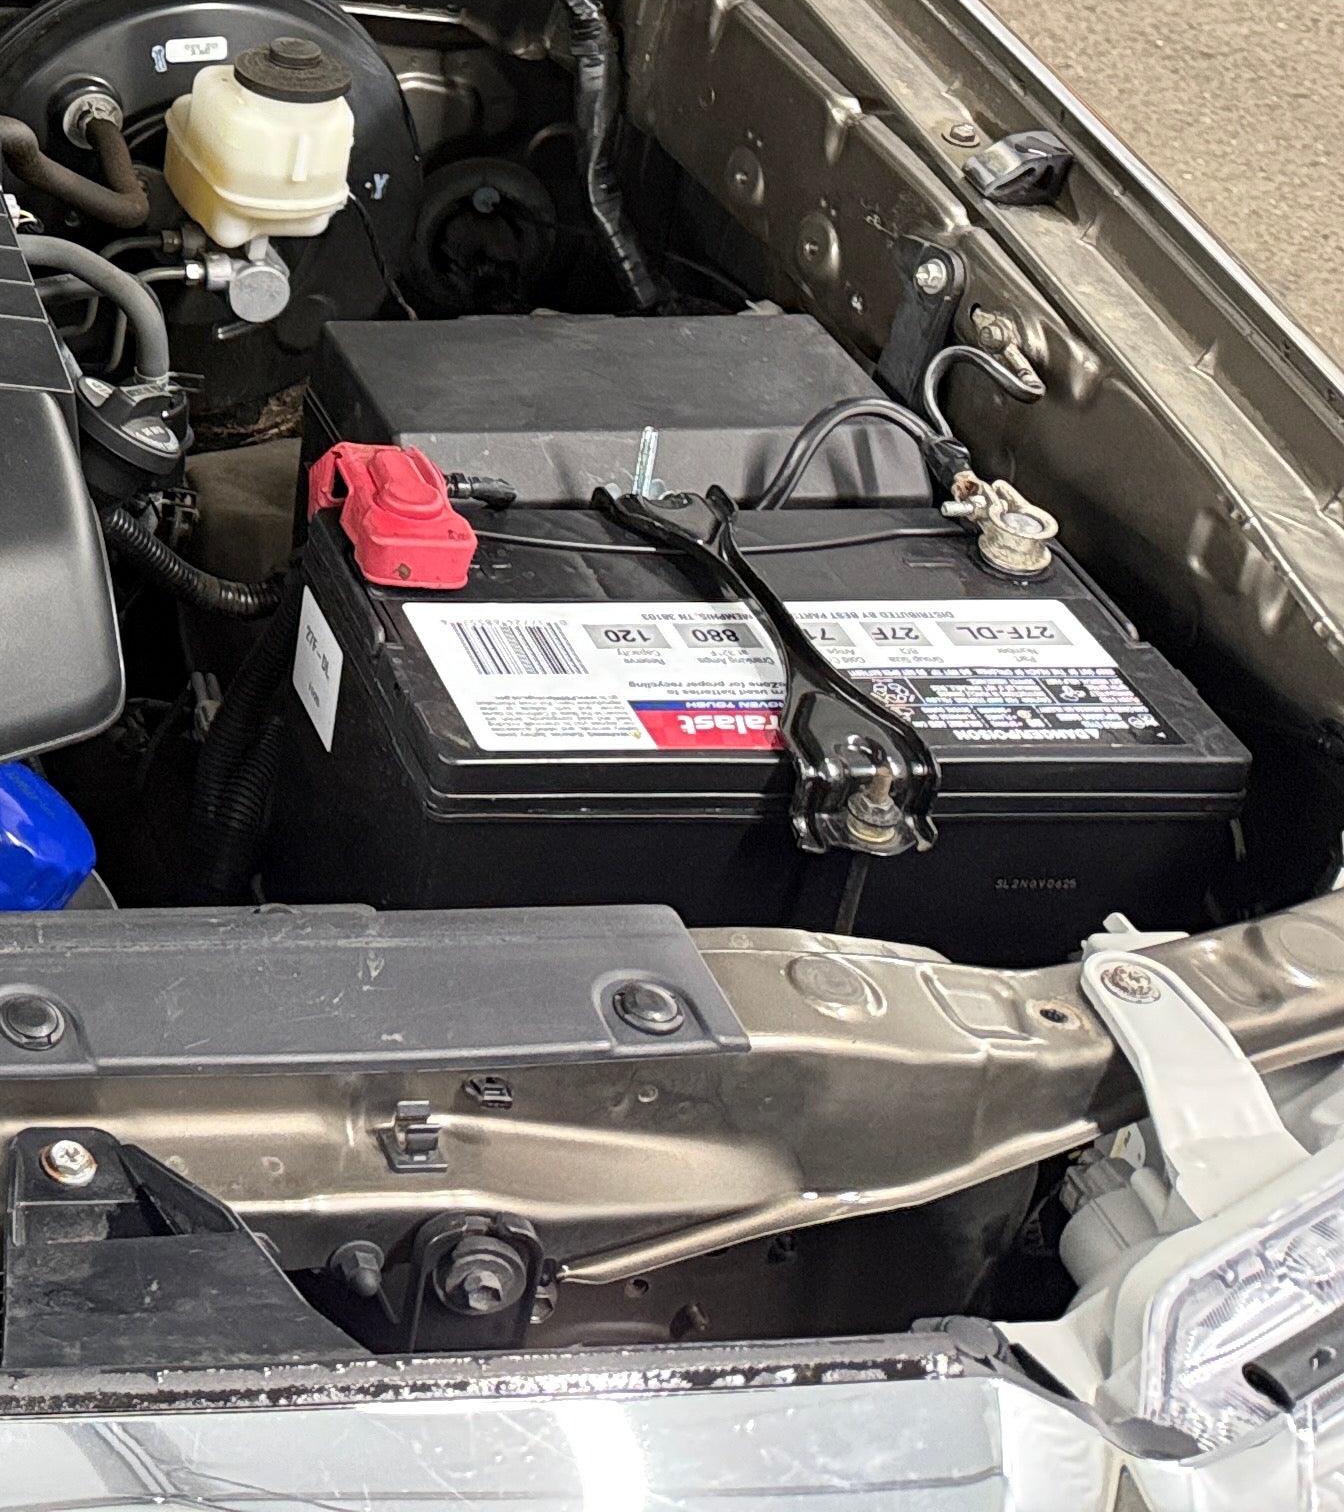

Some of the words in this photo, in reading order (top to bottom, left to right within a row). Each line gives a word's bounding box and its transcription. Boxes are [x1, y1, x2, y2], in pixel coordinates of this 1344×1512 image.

[830, 611, 859, 619] BEST
[862, 611, 876, 619] BY
[880, 611, 955, 619] DISTRIBUTED
[604, 629, 652, 643] 120
[691, 628, 740, 643] 880
[871, 626, 920, 641] 27F
[956, 626, 1055, 640] 27F-DL
[628, 680, 683, 690] recycling
[677, 714, 780, 735] ralast
